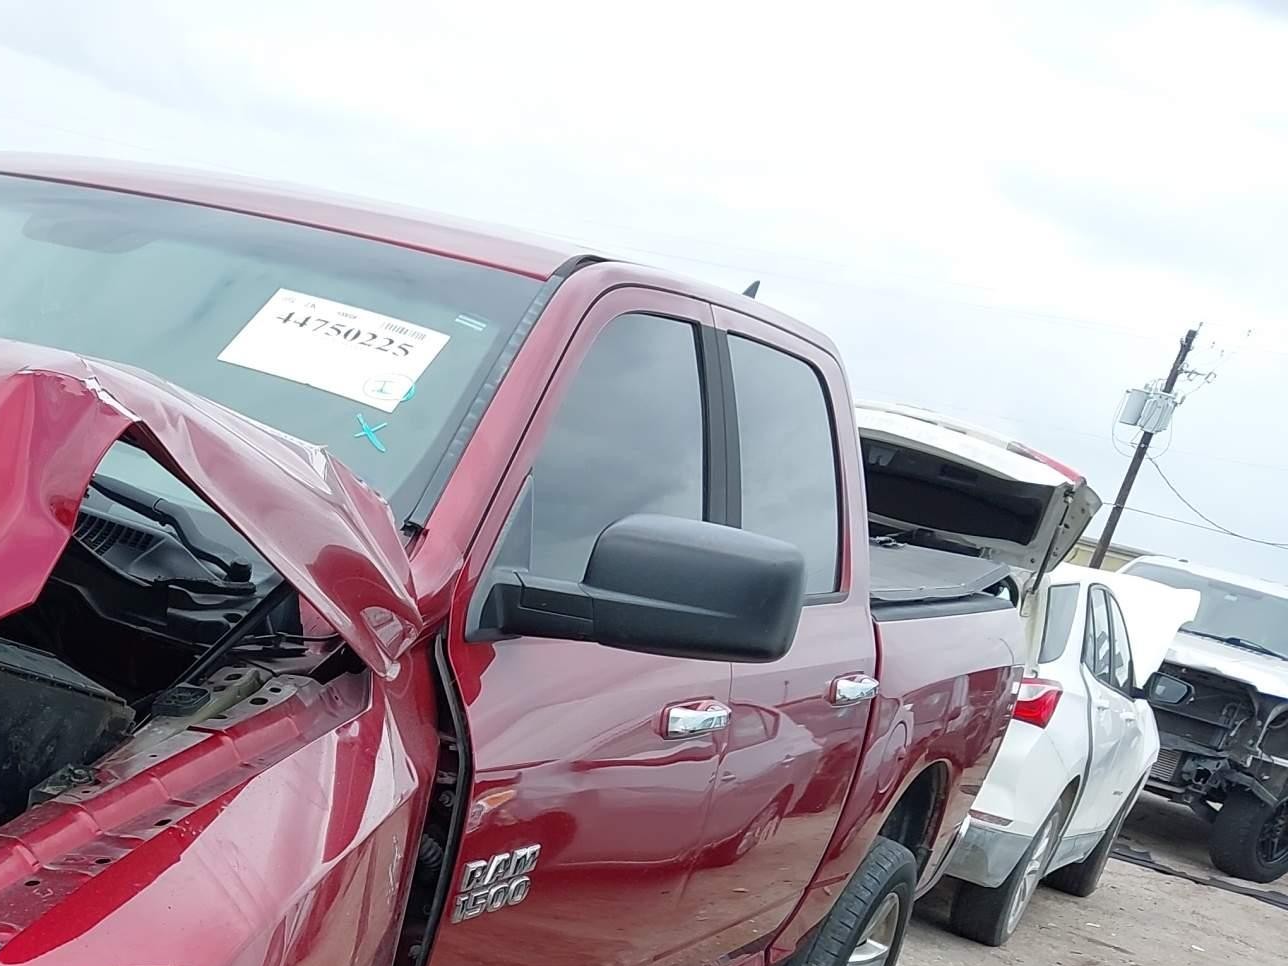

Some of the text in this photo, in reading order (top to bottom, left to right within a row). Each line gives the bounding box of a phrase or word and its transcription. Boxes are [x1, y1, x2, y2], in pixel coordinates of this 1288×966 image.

[274, 311, 414, 358] 44750225
[460, 844, 541, 892] RAM
[451, 876, 530, 924] 1500
